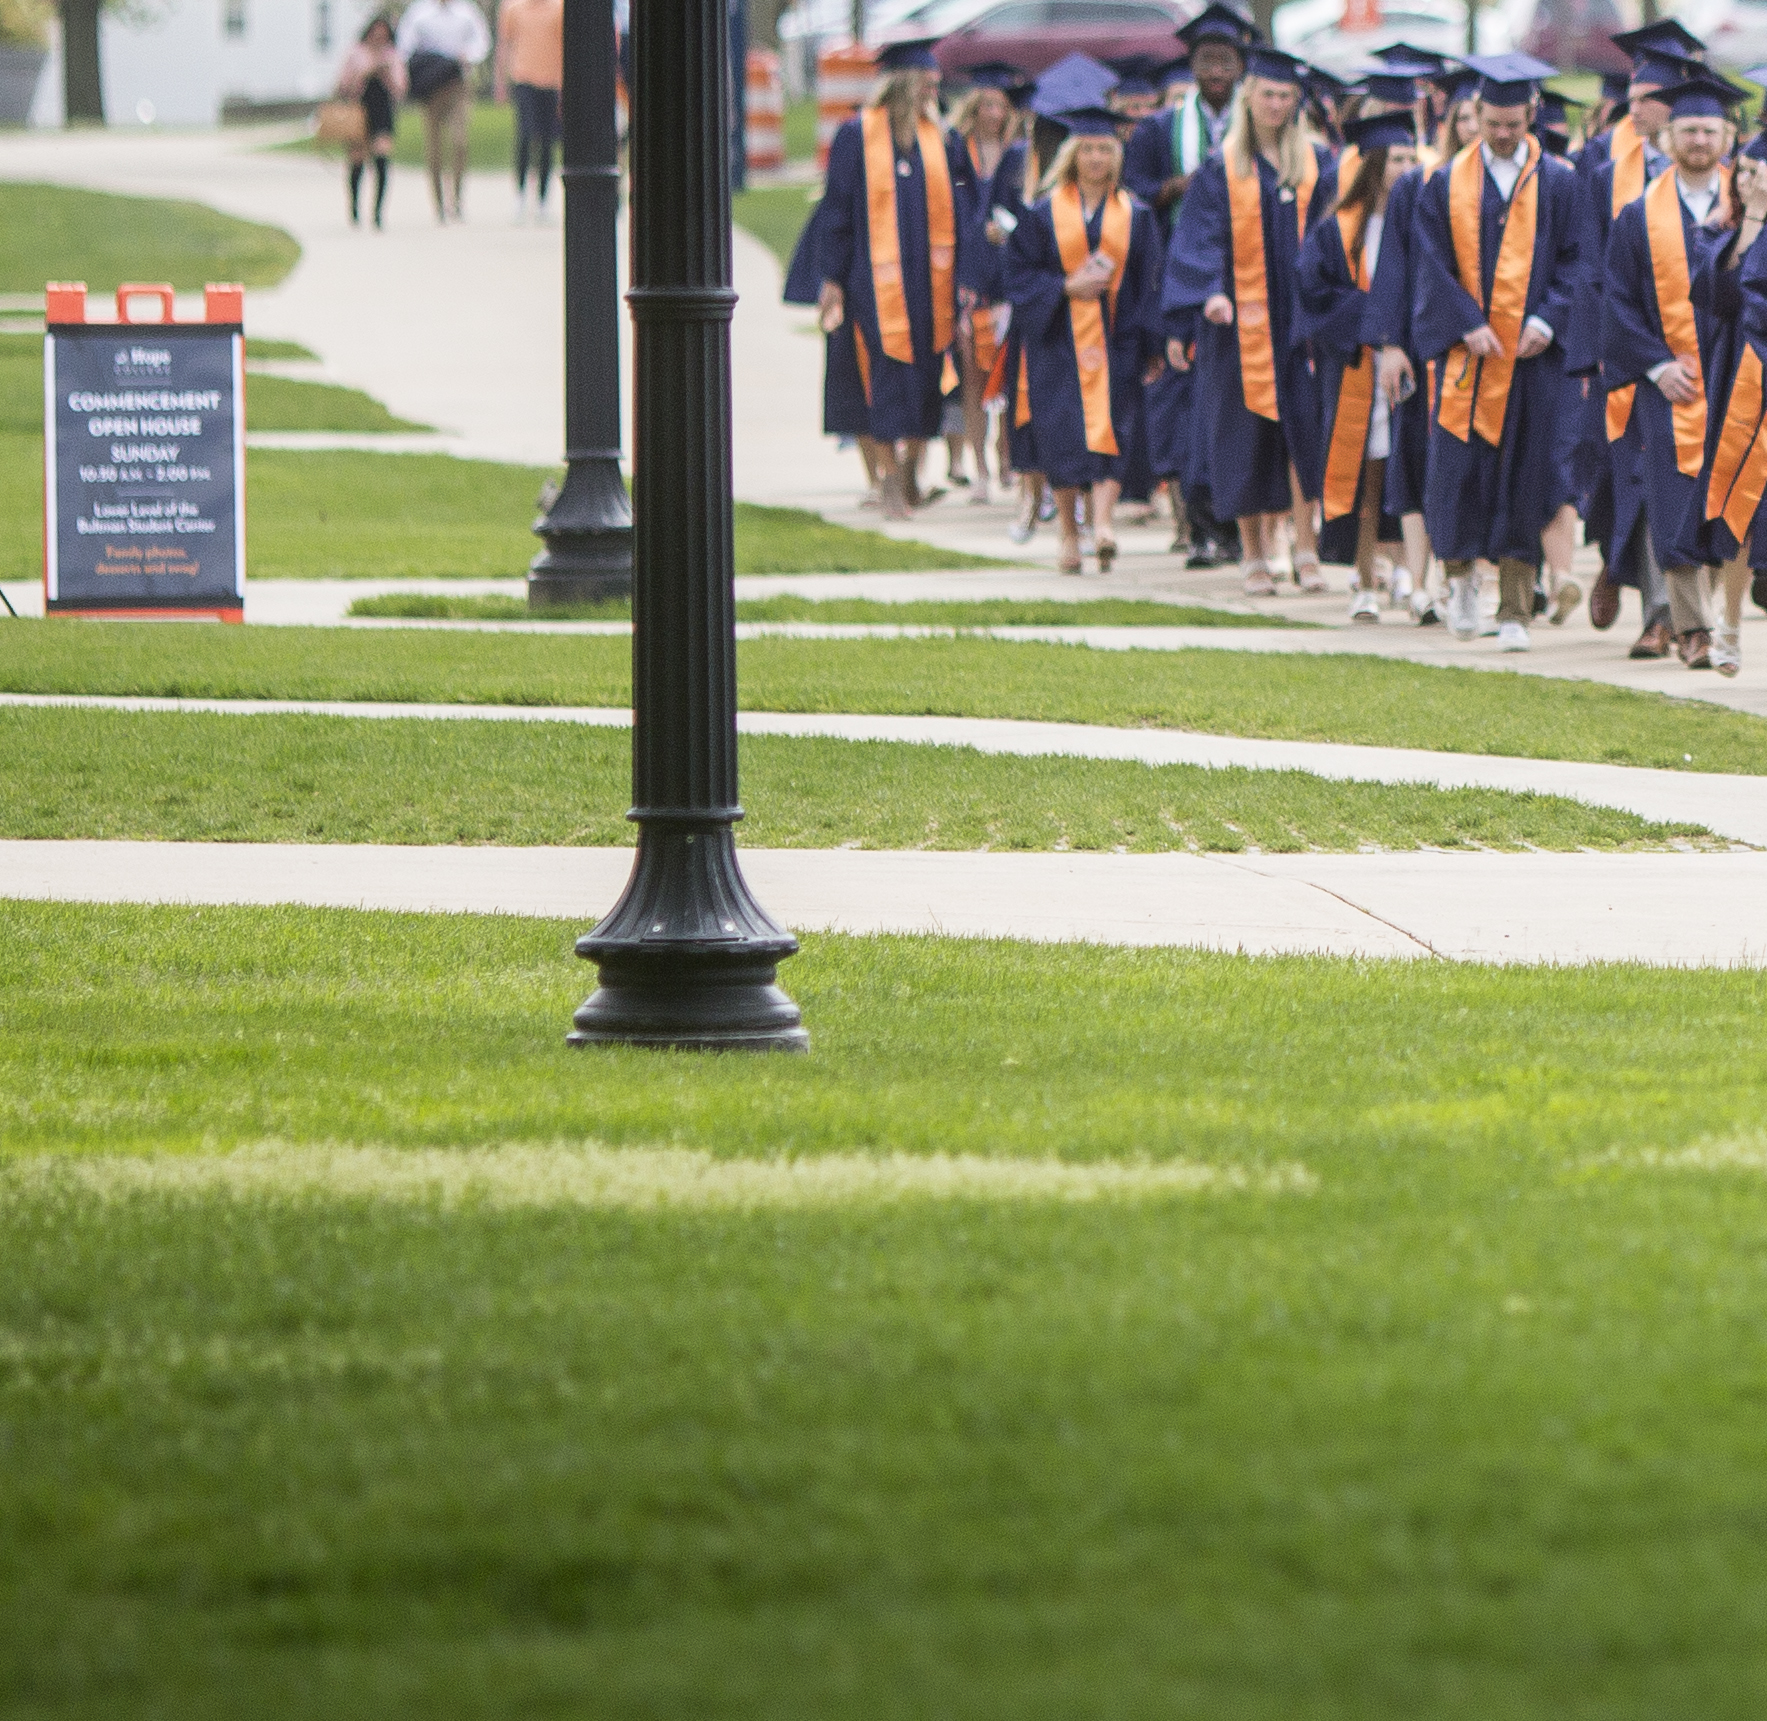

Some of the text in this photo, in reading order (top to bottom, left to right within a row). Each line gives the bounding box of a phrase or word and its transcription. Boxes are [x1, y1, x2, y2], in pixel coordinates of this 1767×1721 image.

[131, 346, 171, 367] Hope
[68, 390, 221, 411] COMMENCEMENT
[88, 416, 201, 437] OPEN HOUSE
[111, 442, 180, 463] SUNDAY
[164, 500, 178, 517] of
[179, 500, 199, 517] the
